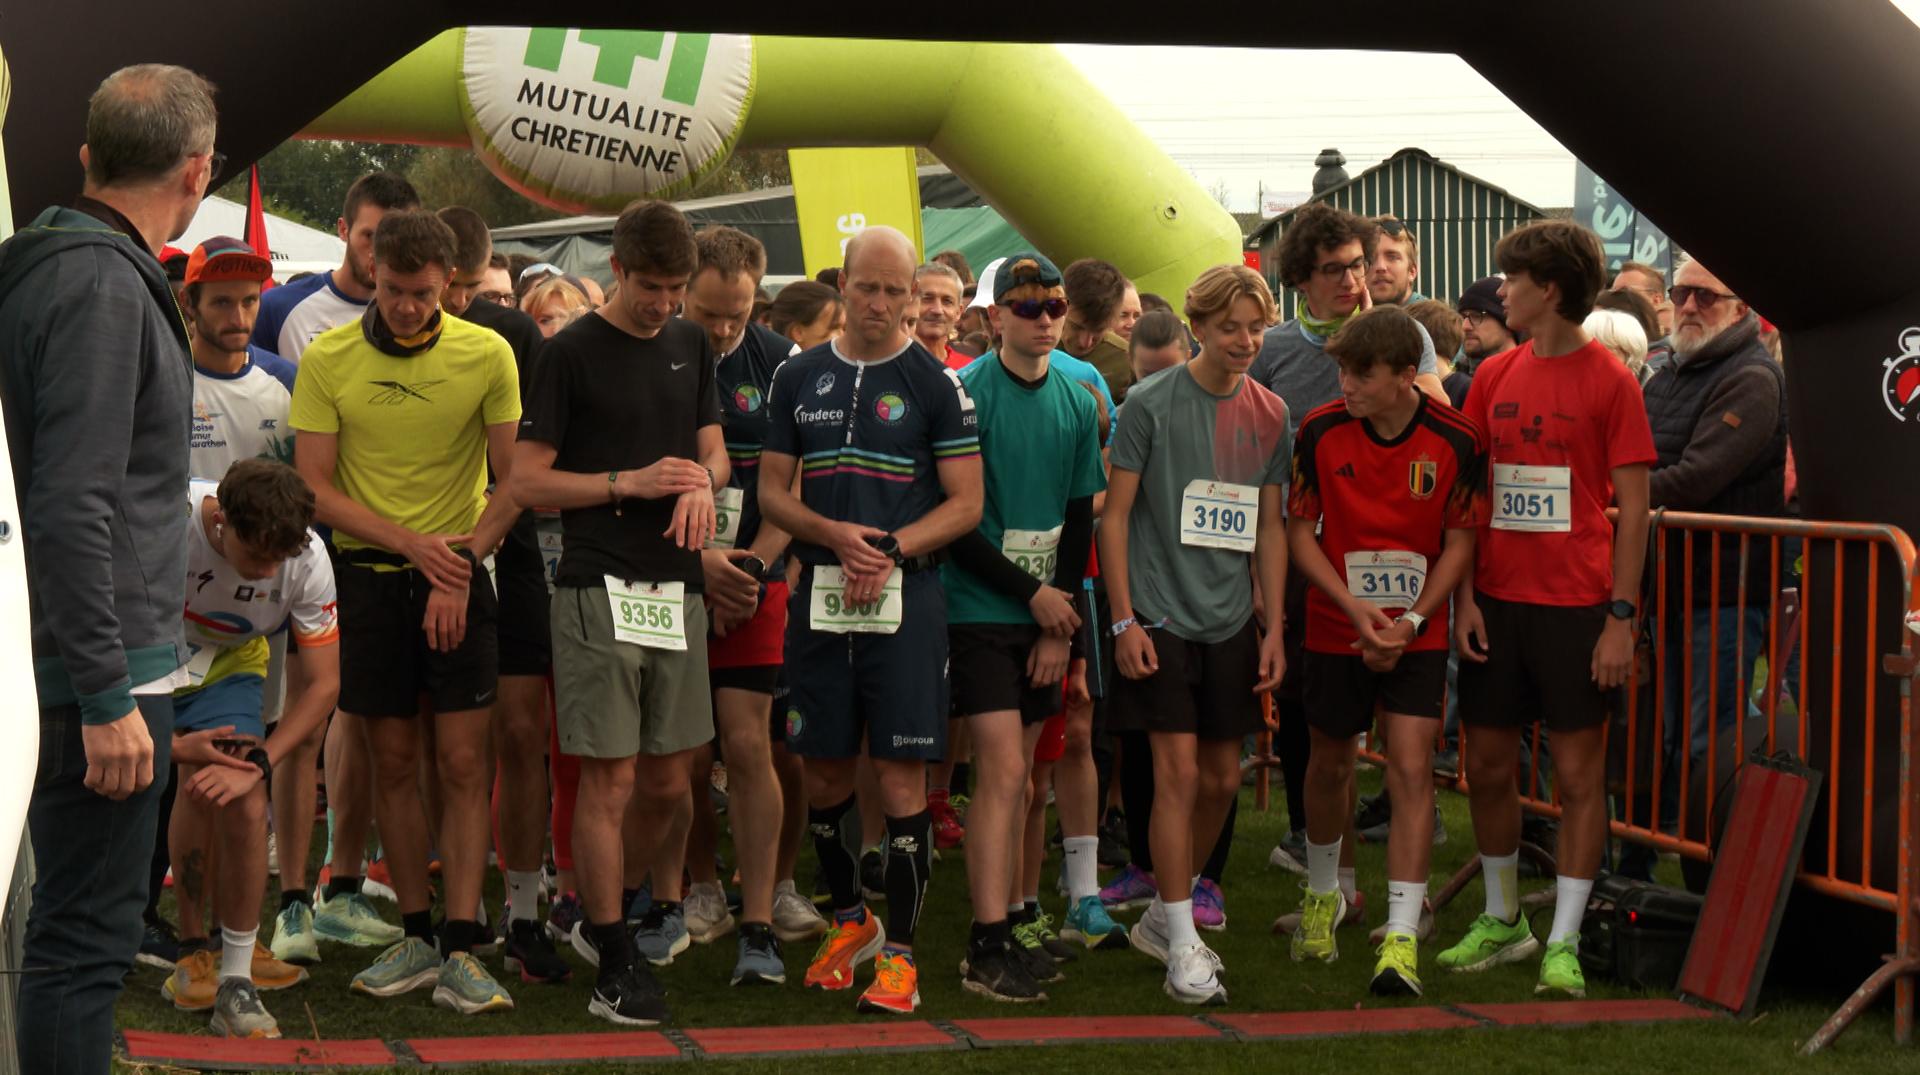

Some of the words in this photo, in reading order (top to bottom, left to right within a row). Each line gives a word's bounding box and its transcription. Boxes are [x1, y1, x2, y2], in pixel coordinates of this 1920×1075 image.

[517, 78, 692, 142] MUTUALITE
[511, 116, 681, 174] CHRETIENNE
[798, 406, 844, 424] Tradeco
[1502, 492, 1554, 517] 3051
[1193, 505, 1246, 533] 3190
[1361, 572, 1419, 596] 3116
[620, 600, 673, 630] 9356
